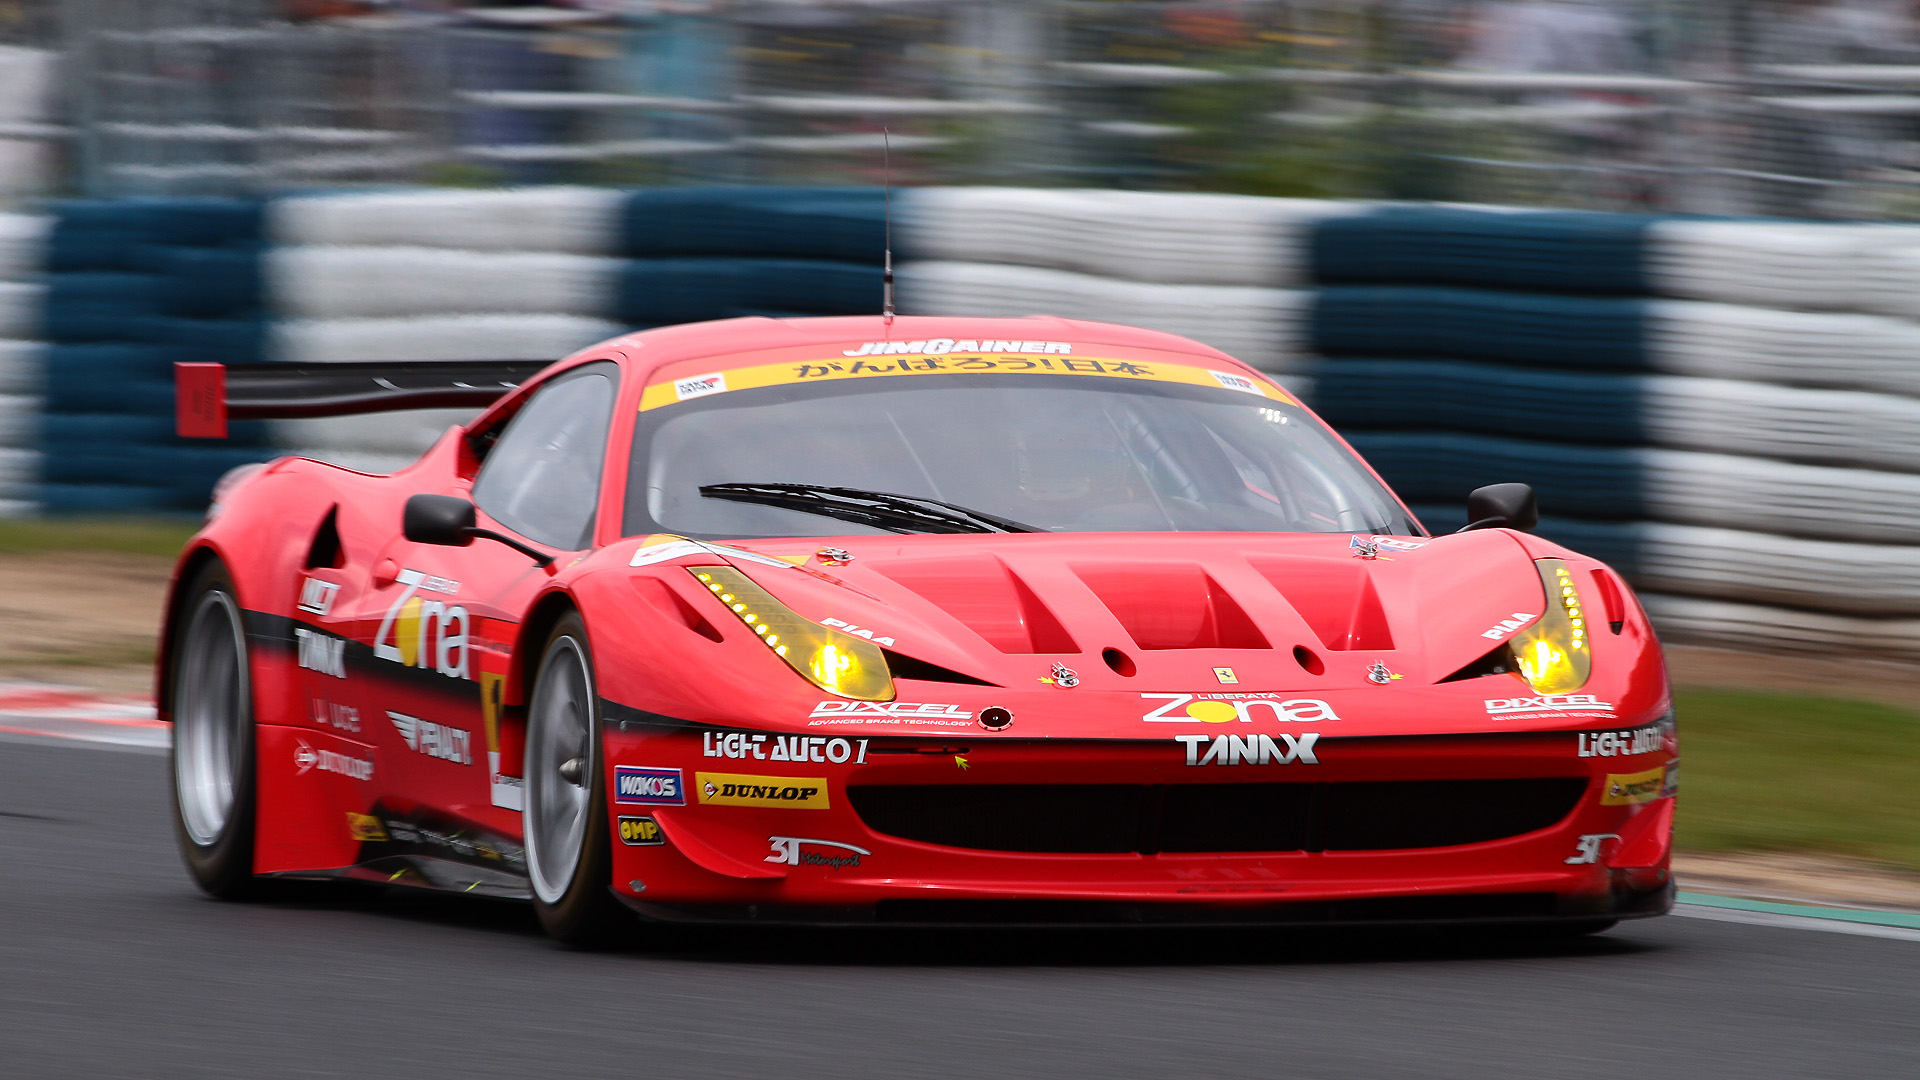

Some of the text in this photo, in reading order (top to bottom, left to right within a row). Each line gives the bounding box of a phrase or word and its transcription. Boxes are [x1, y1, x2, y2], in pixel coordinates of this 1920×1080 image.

[843, 338, 1072, 356] JIMGAINER
[820, 617, 895, 647] PIAA
[1481, 612, 1537, 640] PIAA
[1197, 692, 1281, 700] LIBERATA
[1484, 694, 1612, 711] DIXCEL
[812, 700, 973, 718] DIXCEL
[1140, 693, 1342, 723] Zona
[808, 719, 864, 727] ADVANCED
[903, 719, 973, 727] TECHNOLOGY
[770, 735, 852, 764] AUTO
[1174, 732, 1321, 766] TANAX
[720, 783, 818, 801] DUNLOP
[620, 820, 659, 840] OMP
